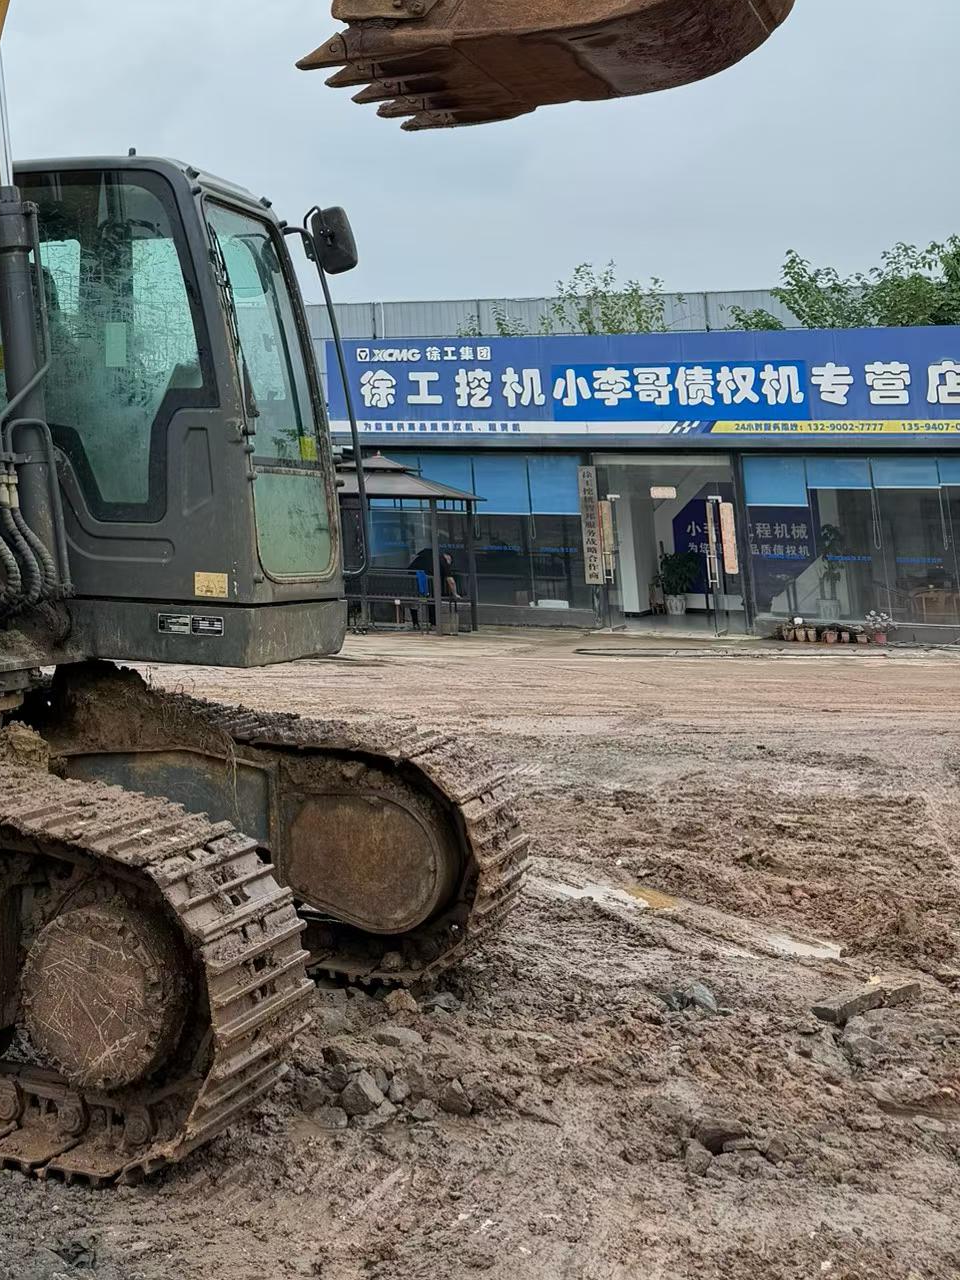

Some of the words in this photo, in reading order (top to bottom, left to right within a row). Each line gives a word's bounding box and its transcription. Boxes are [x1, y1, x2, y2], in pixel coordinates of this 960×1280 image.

[372, 349, 421, 362] XCMG
[426, 346, 491, 361] 徐工集团
